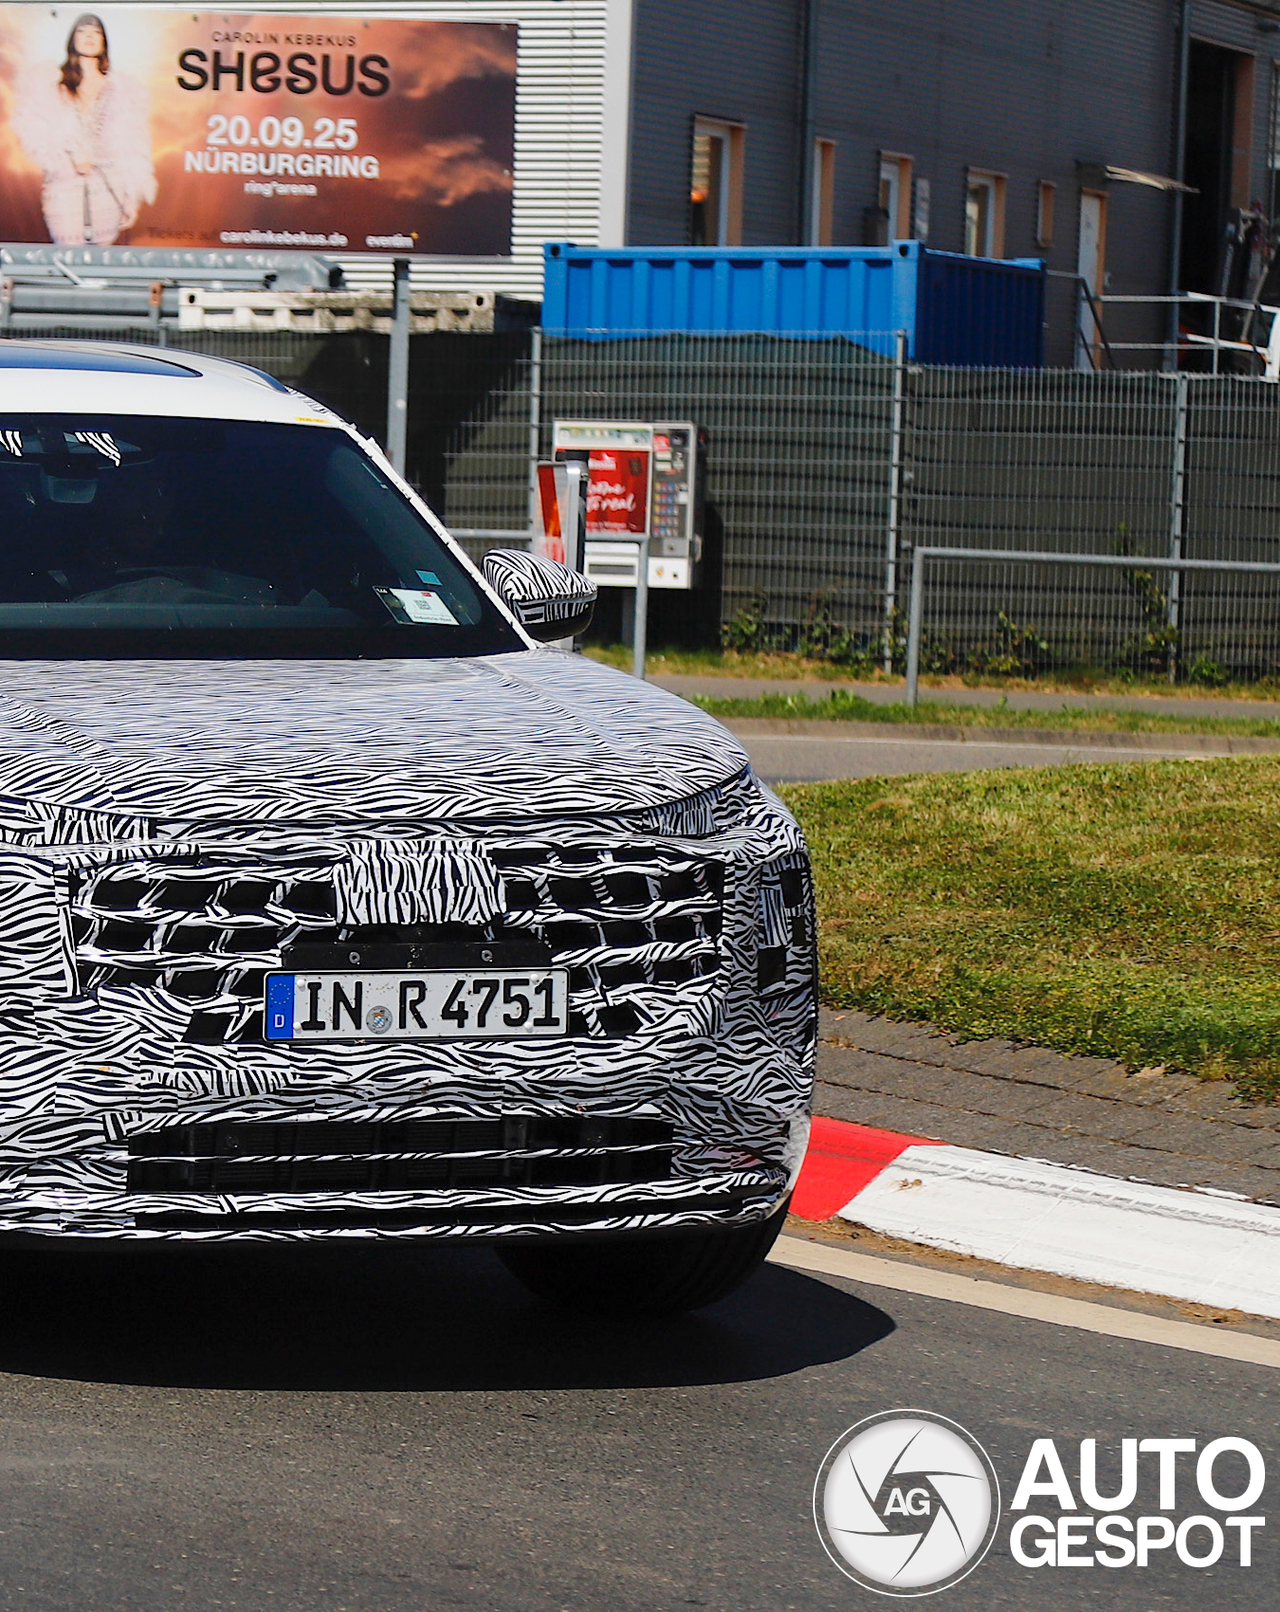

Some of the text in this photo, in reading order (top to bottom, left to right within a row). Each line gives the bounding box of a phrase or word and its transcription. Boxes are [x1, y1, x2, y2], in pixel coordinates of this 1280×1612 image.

[211, 31, 357, 47] CAROLIN KEBEKUS
[206, 114, 359, 150] 20.09.25
[184, 146, 381, 179] NÜRBURGRING
[219, 228, 349, 247] carolinkebekus.de
[301, 977, 561, 1031] IN R 4751
[274, 1013, 285, 1028] D
